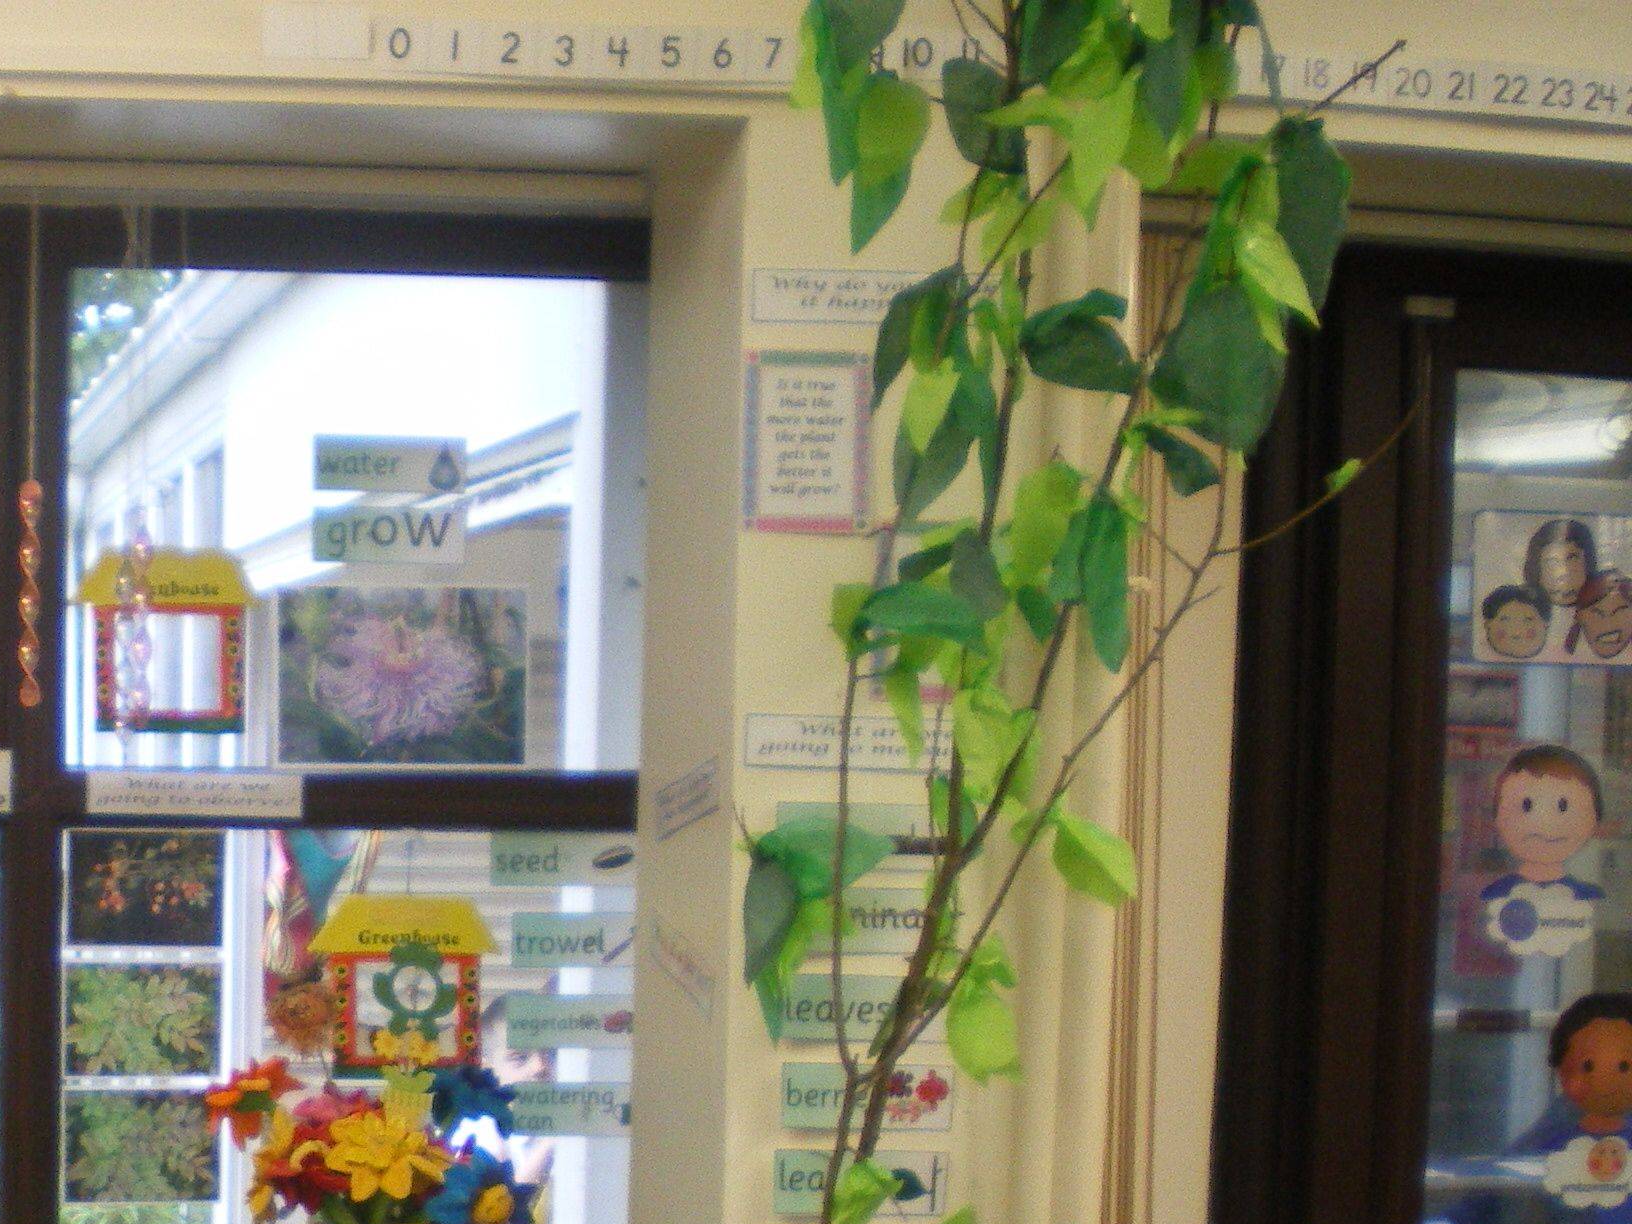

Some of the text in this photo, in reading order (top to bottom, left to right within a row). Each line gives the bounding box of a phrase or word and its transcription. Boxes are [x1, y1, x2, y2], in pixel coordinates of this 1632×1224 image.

[389, 28, 411, 58] 0
[450, 31, 459, 60] 1
[500, 33, 521, 64] 2
[554, 36, 574, 67] 3
[606, 36, 628, 67] 4
[660, 37, 681, 68] 5
[713, 37, 733, 68] 6
[766, 37, 782, 68] 7
[903, 38, 933, 67] 10
[1395, 67, 1432, 97] 20
[1448, 70, 1475, 100] 21
[1492, 73, 1529, 104] 22
[1541, 76, 1574, 108] 23
[1584, 80, 1618, 113] 24
[319, 450, 400, 476] water
[494, 846, 560, 873] seed
[513, 928, 605, 954] trowel
[779, 1159, 828, 1192] lea
